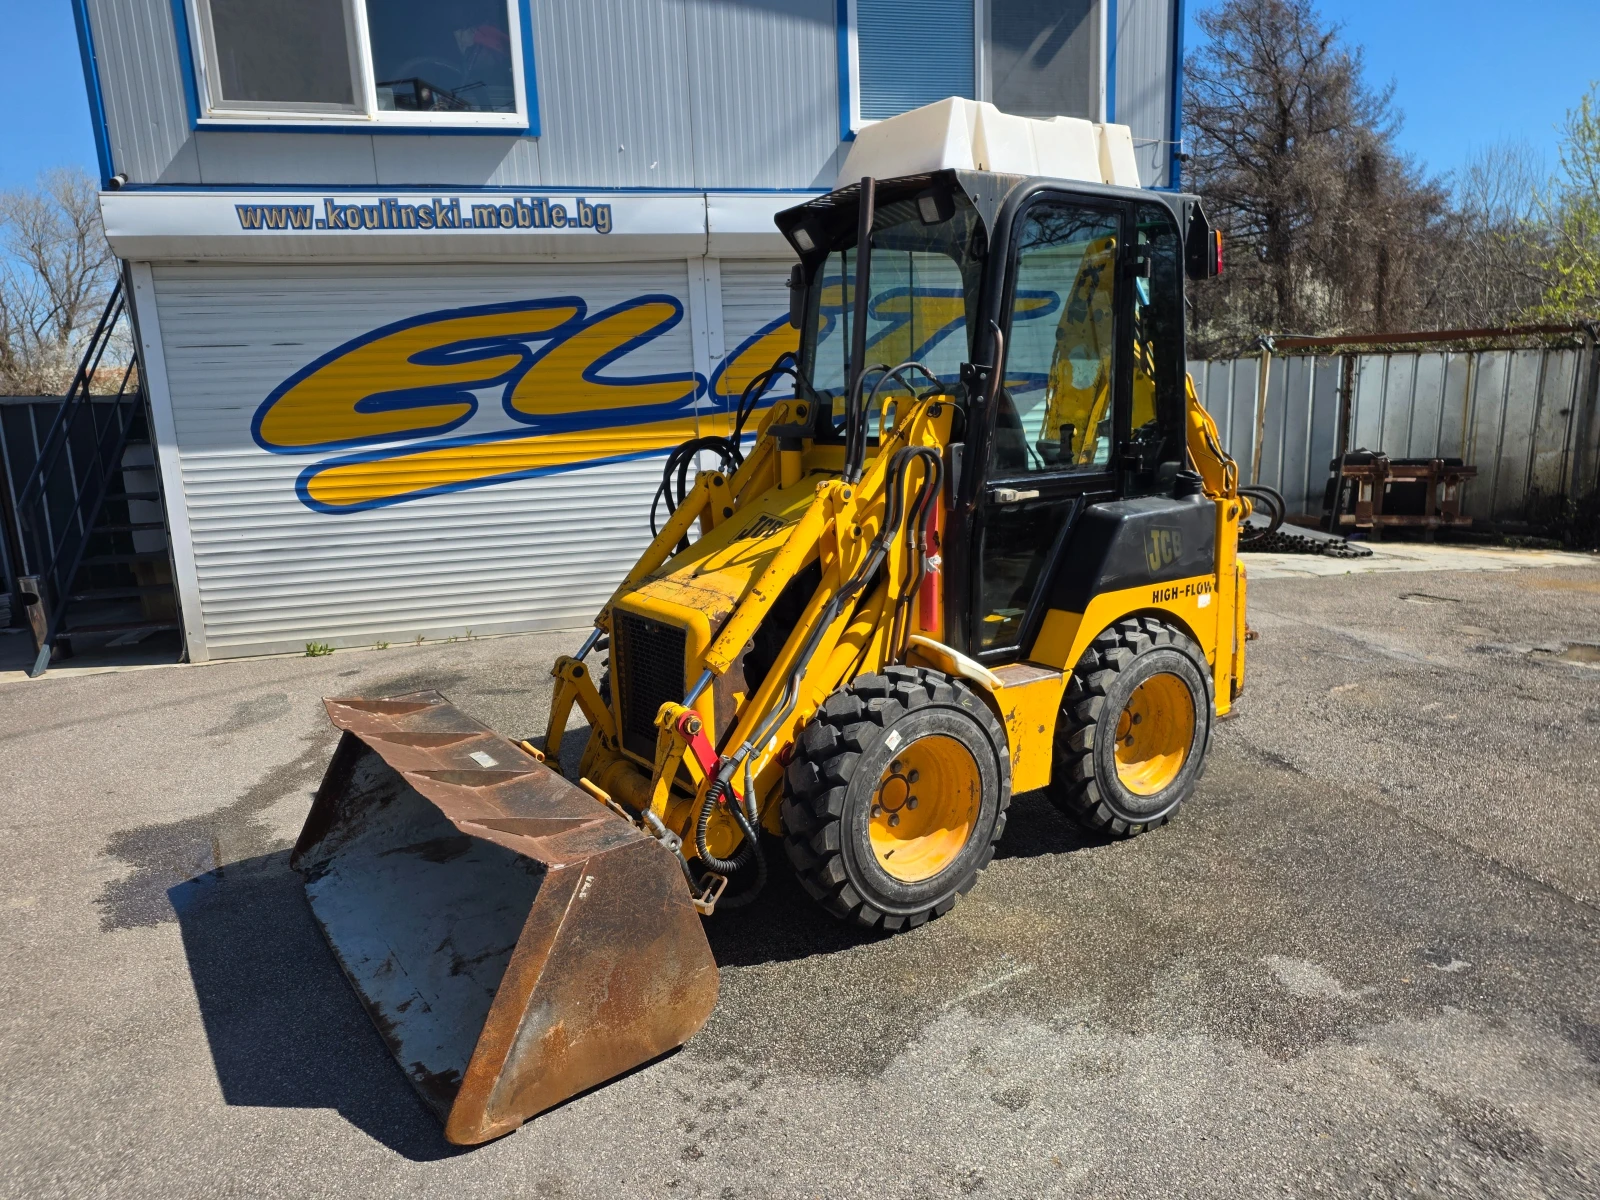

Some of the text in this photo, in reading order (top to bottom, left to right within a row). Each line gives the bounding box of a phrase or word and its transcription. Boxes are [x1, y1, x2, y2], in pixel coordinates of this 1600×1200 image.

[235, 198, 613, 234] www.koulinski.mobile.bg
[1149, 529, 1183, 571] JCB
[1152, 581, 1212, 604] HIGH-FLOW
